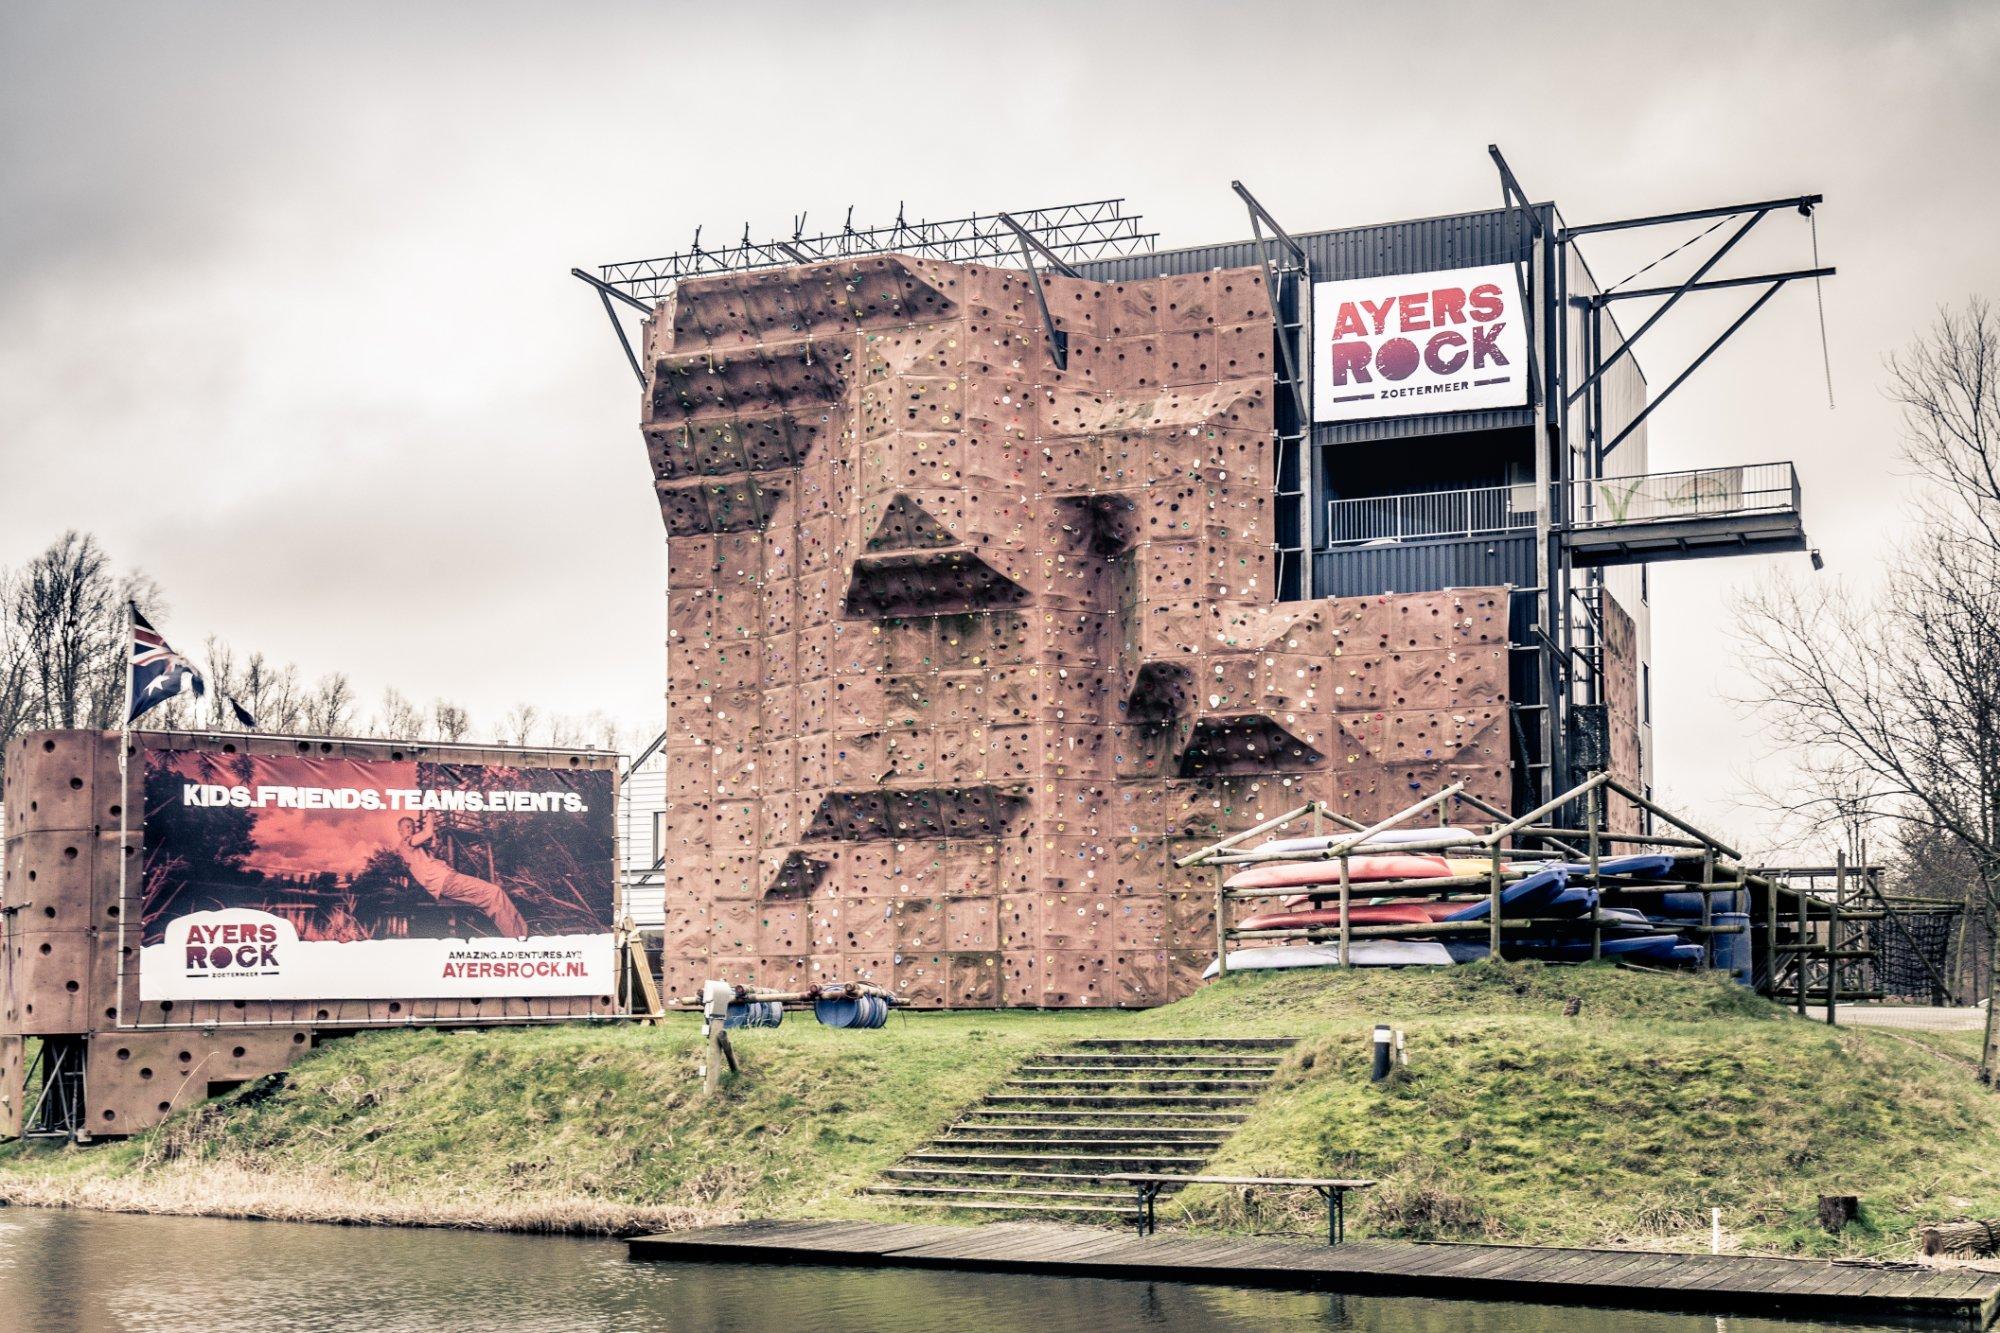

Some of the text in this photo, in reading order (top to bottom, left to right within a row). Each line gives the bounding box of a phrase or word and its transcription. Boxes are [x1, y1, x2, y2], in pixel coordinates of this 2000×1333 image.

[1332, 284, 1504, 341] AYERS
[1332, 322, 1510, 386] ROCK
[1380, 381, 1469, 399] ZOETERMEER
[186, 924, 277, 944] AYERS
[186, 944, 279, 969] ROCK
[442, 962, 588, 978] AYERSROCK.NL
